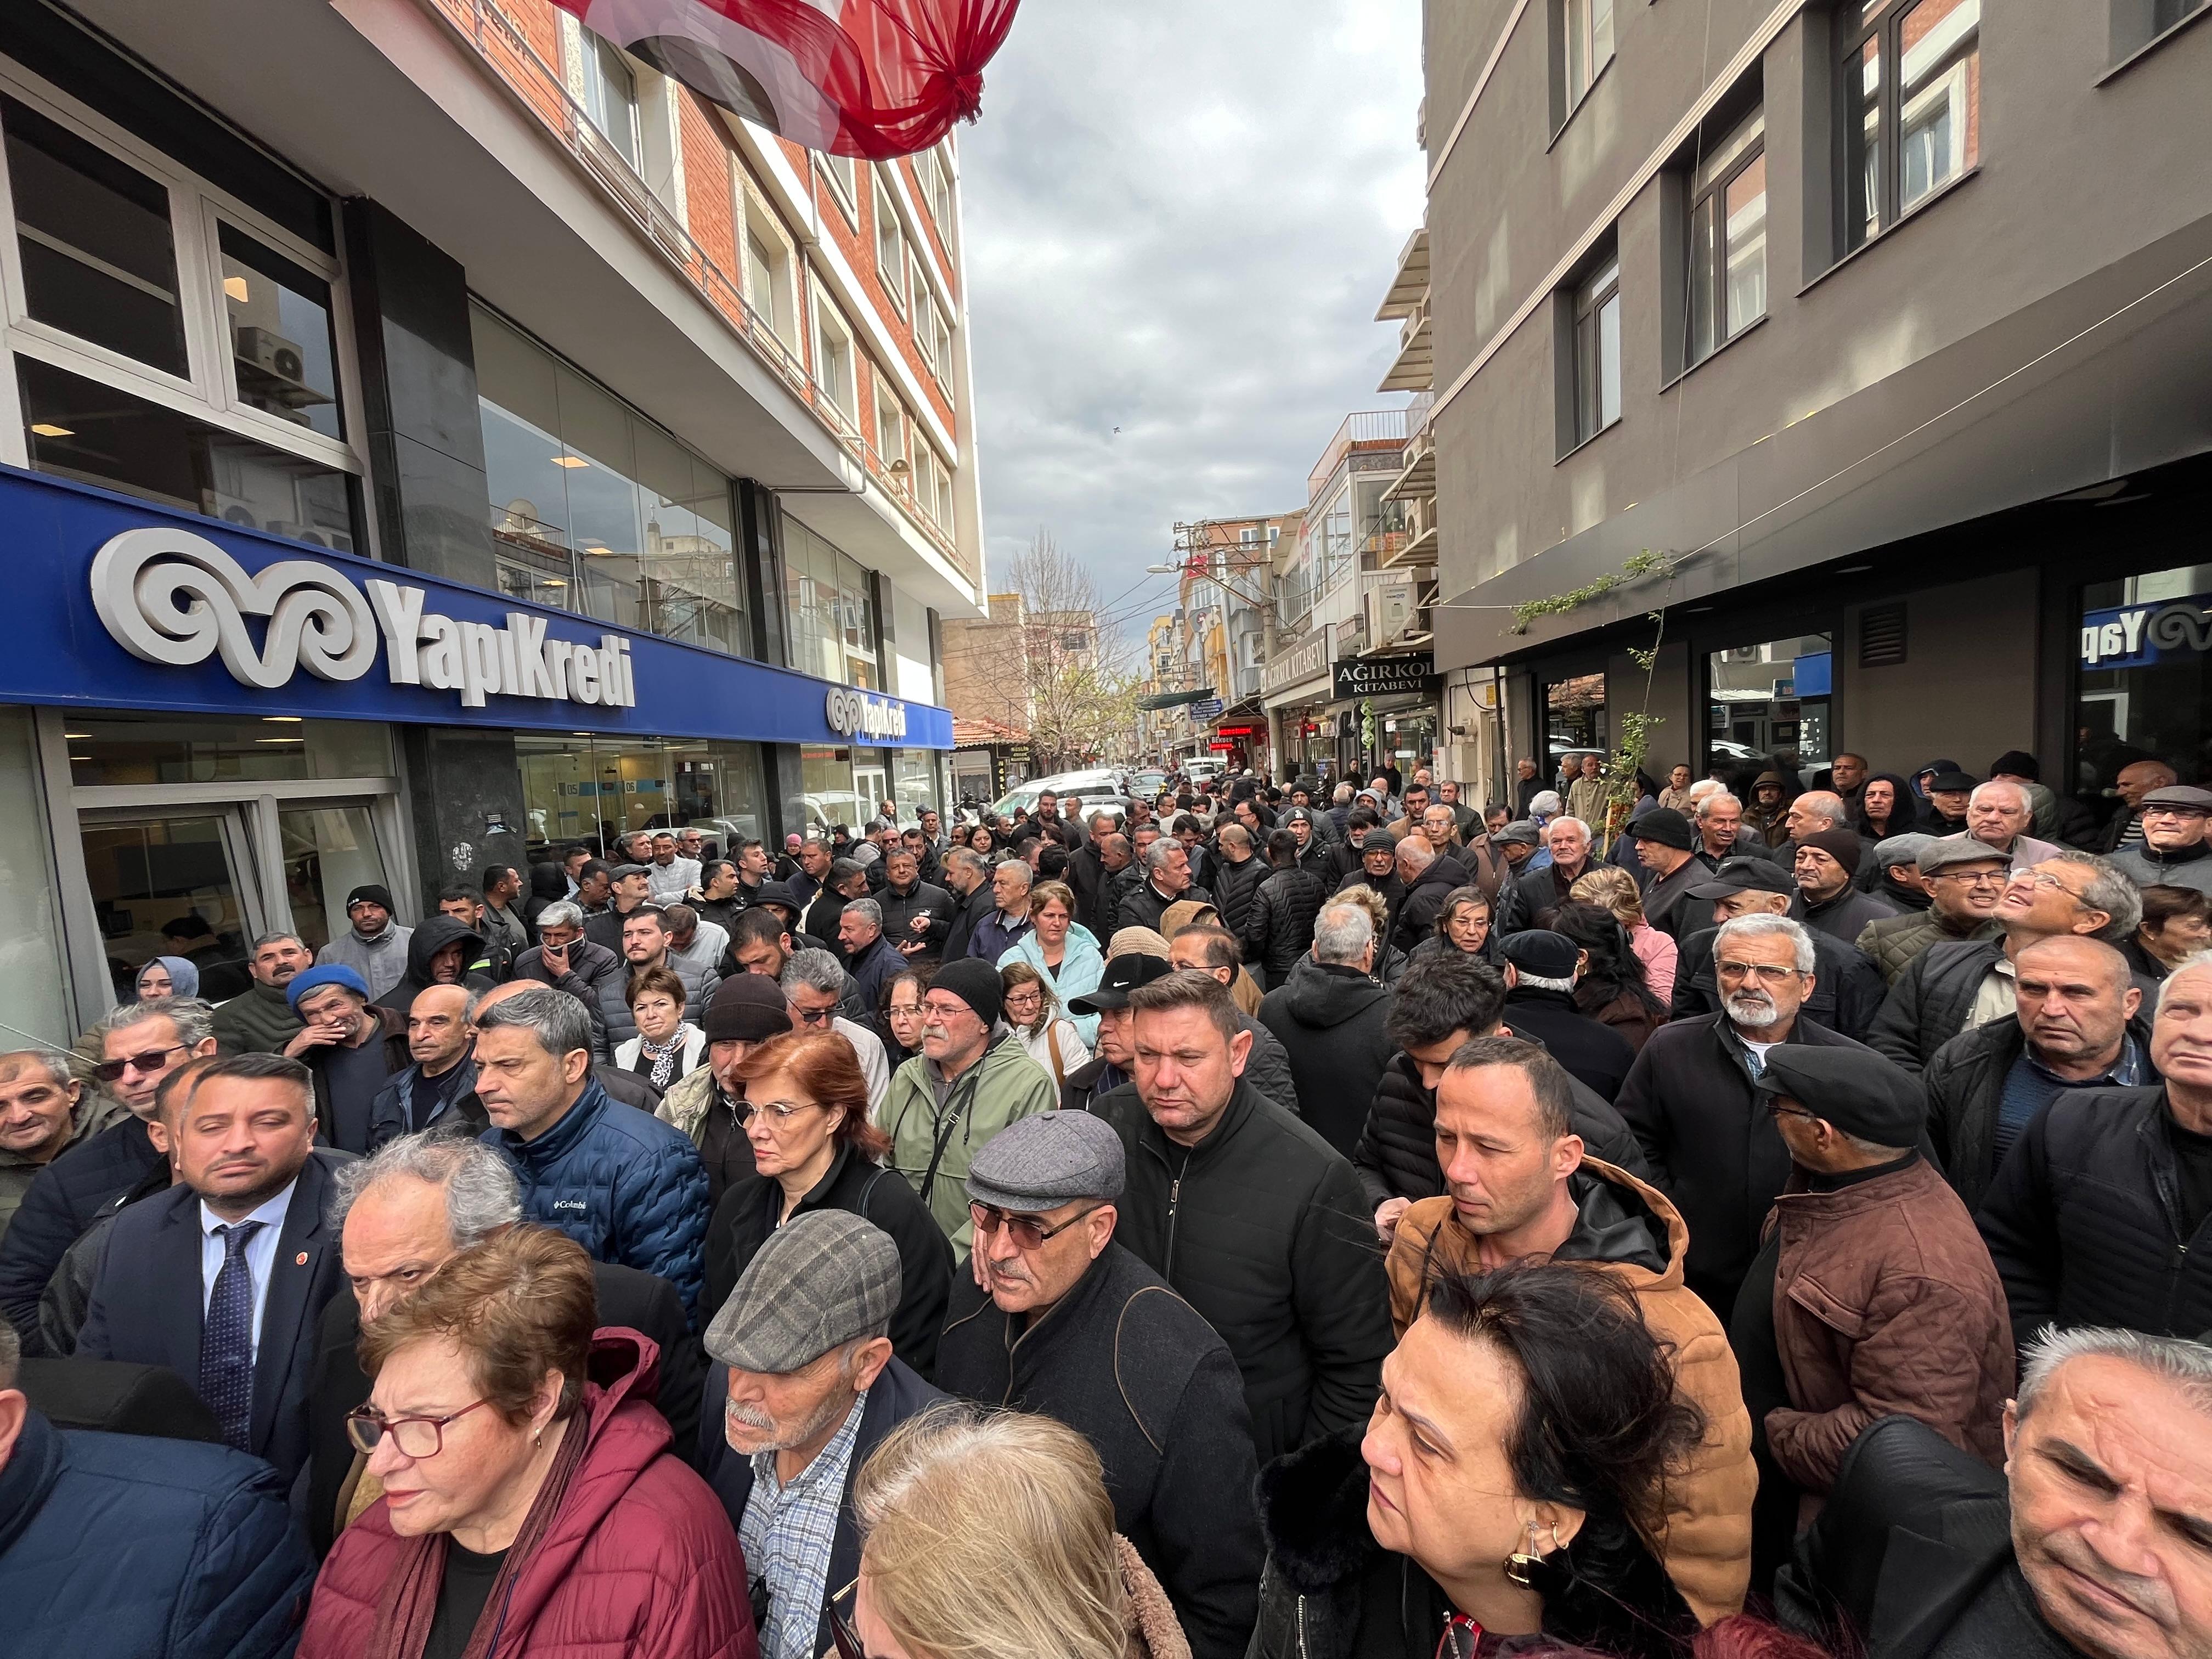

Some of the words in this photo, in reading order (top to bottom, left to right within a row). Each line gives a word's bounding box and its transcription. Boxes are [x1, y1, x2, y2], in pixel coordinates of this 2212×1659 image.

[364, 579, 635, 707] YapıKredi
[1267, 658, 1291, 690] AĞIRKOL
[1291, 632, 1326, 679] KİTABEVİ
[1337, 662, 1435, 682] AĞIRKOL
[1353, 678, 1422, 693] KİTABEVİ
[860, 693, 906, 739] YapıKredi
[567, 784, 577, 794] 05
[626, 782, 635, 792] 06
